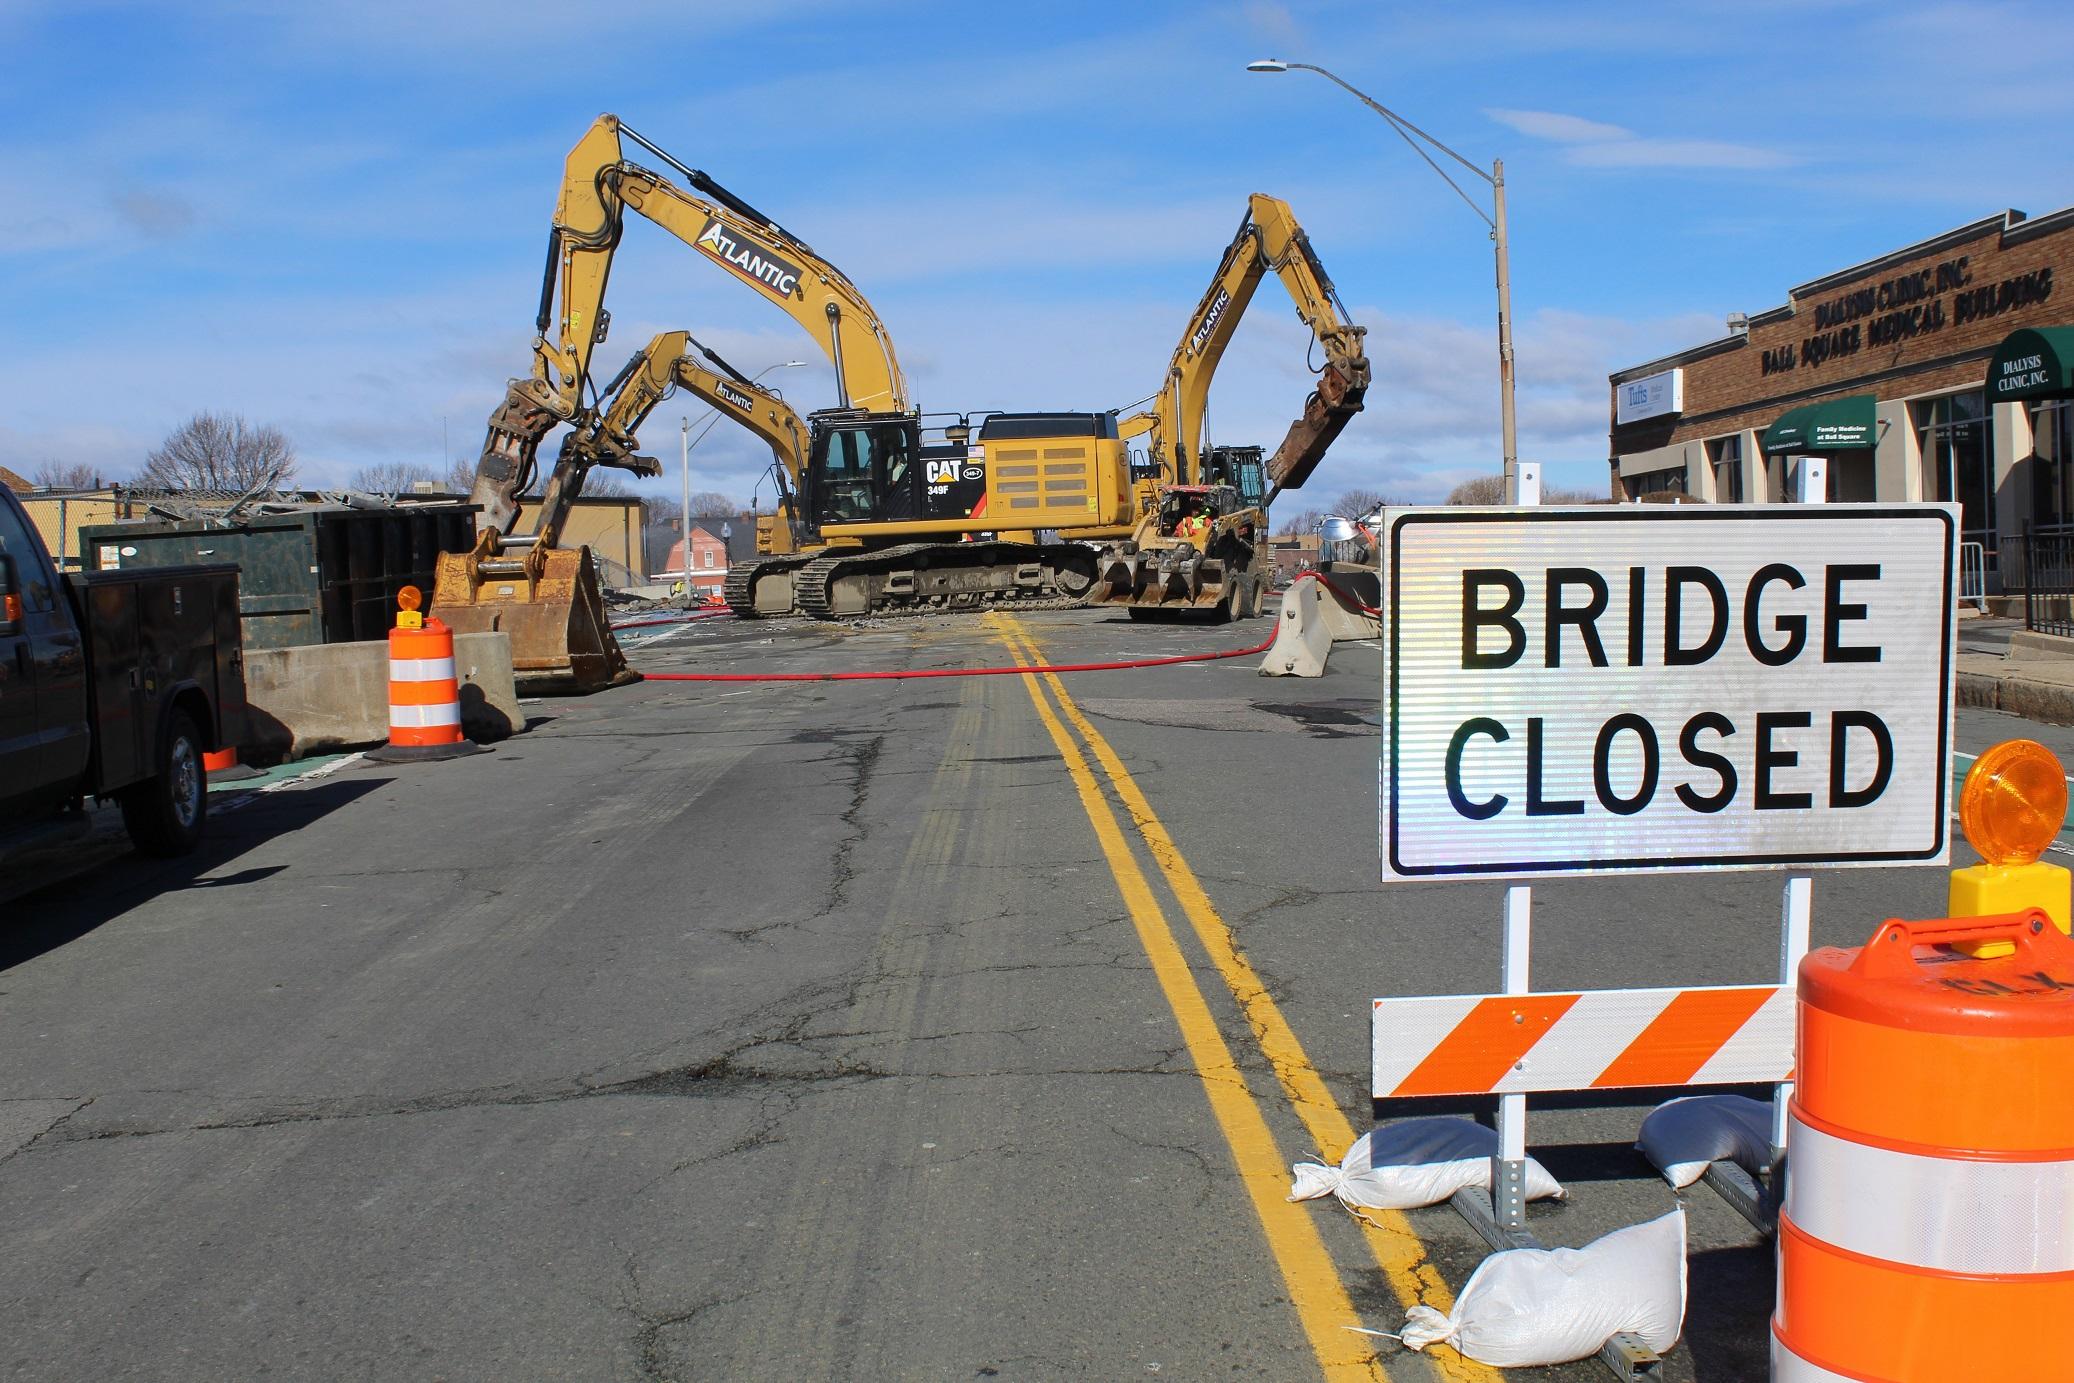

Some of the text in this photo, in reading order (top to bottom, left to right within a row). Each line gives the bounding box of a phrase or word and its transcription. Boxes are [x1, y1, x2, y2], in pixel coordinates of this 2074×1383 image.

[698, 222, 796, 294] ATLANTIC
[1192, 290, 1228, 351] ATLANTIC
[1762, 267, 2054, 377] BALL SQUARE MEDICAL BUILDING
[2003, 354, 2042, 374] DIALYSIS
[1627, 384, 1648, 407] Tufts
[1998, 369, 2049, 392] CLINIC, INC.
[715, 382, 752, 412] ATLANTIC
[926, 460, 962, 484] CAT
[927, 485, 949, 496] 349F
[1461, 563, 1882, 670] BRIDGE
[1444, 710, 1895, 821] CLOSED
